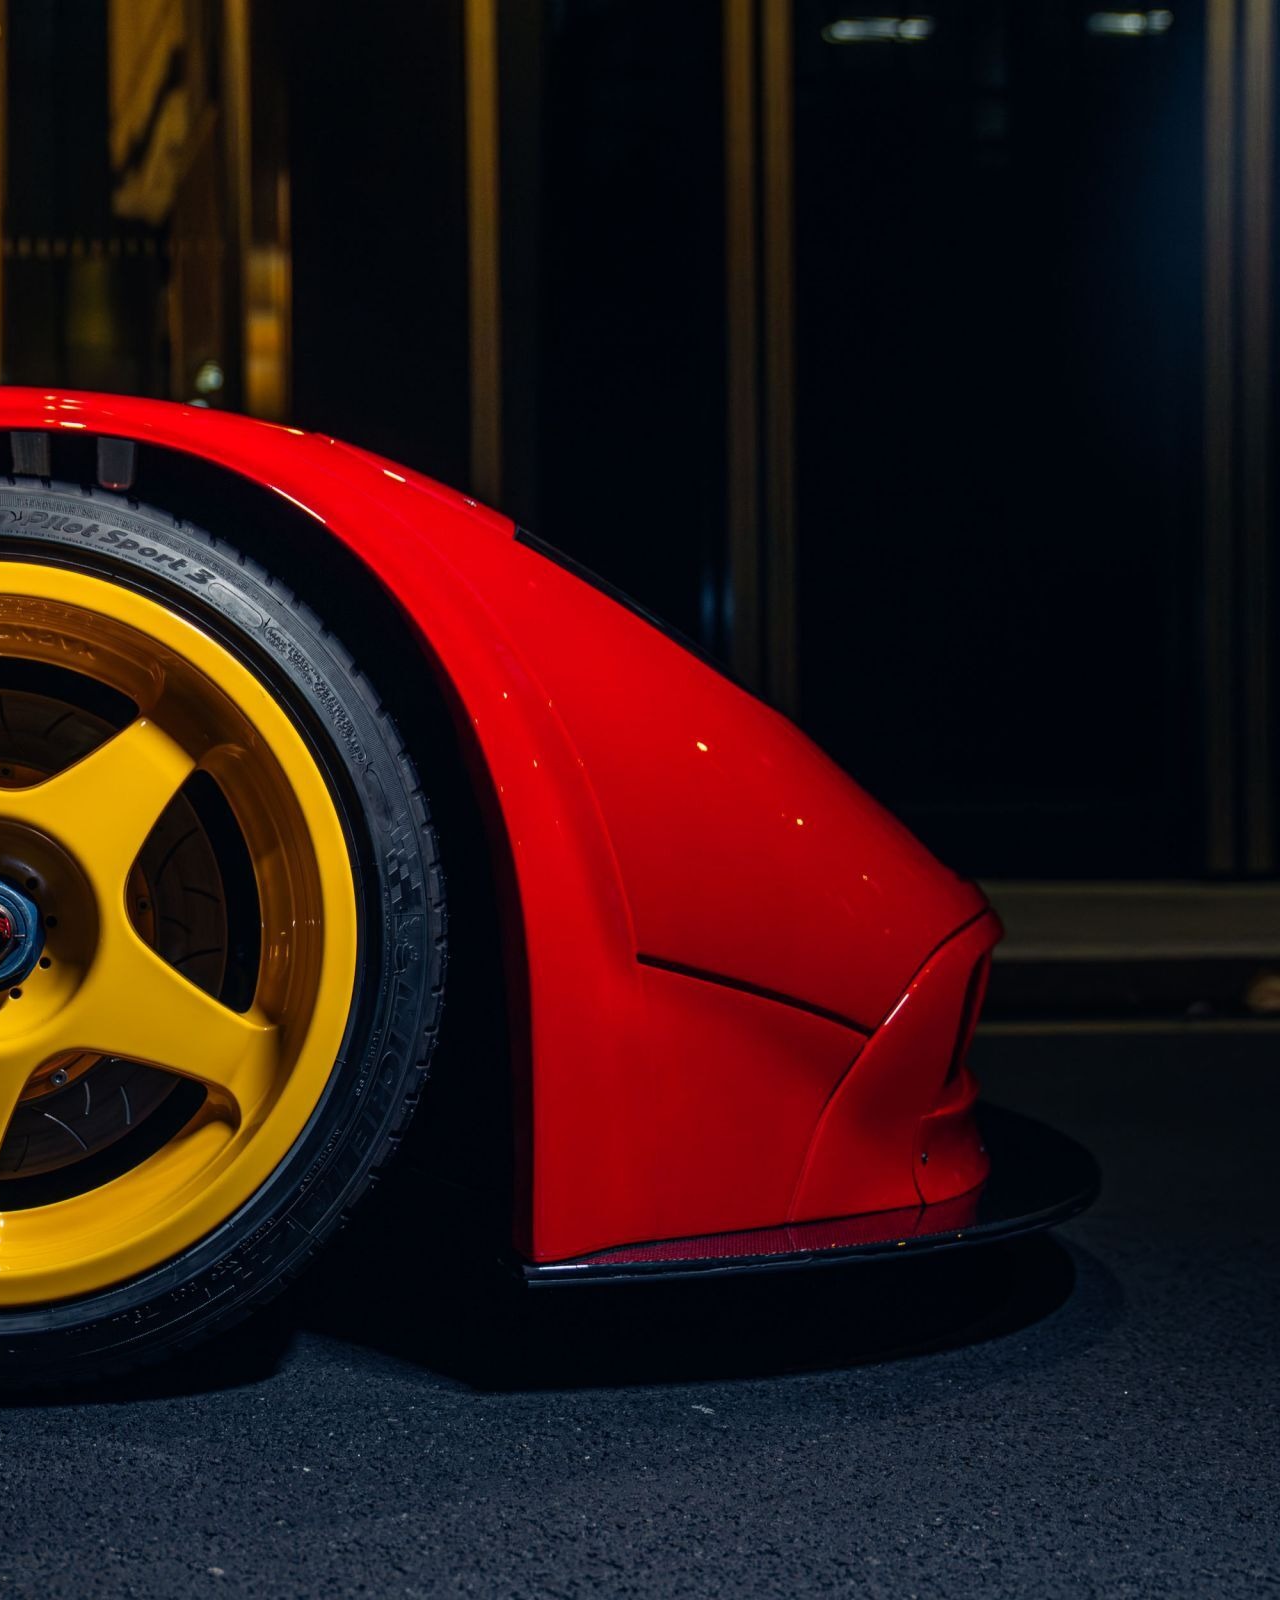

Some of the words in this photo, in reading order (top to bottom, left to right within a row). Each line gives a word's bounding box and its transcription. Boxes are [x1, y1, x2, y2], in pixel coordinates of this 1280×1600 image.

[22, 510, 100, 537] Pilot
[98, 528, 188, 572] Sport
[184, 567, 217, 585] 3
